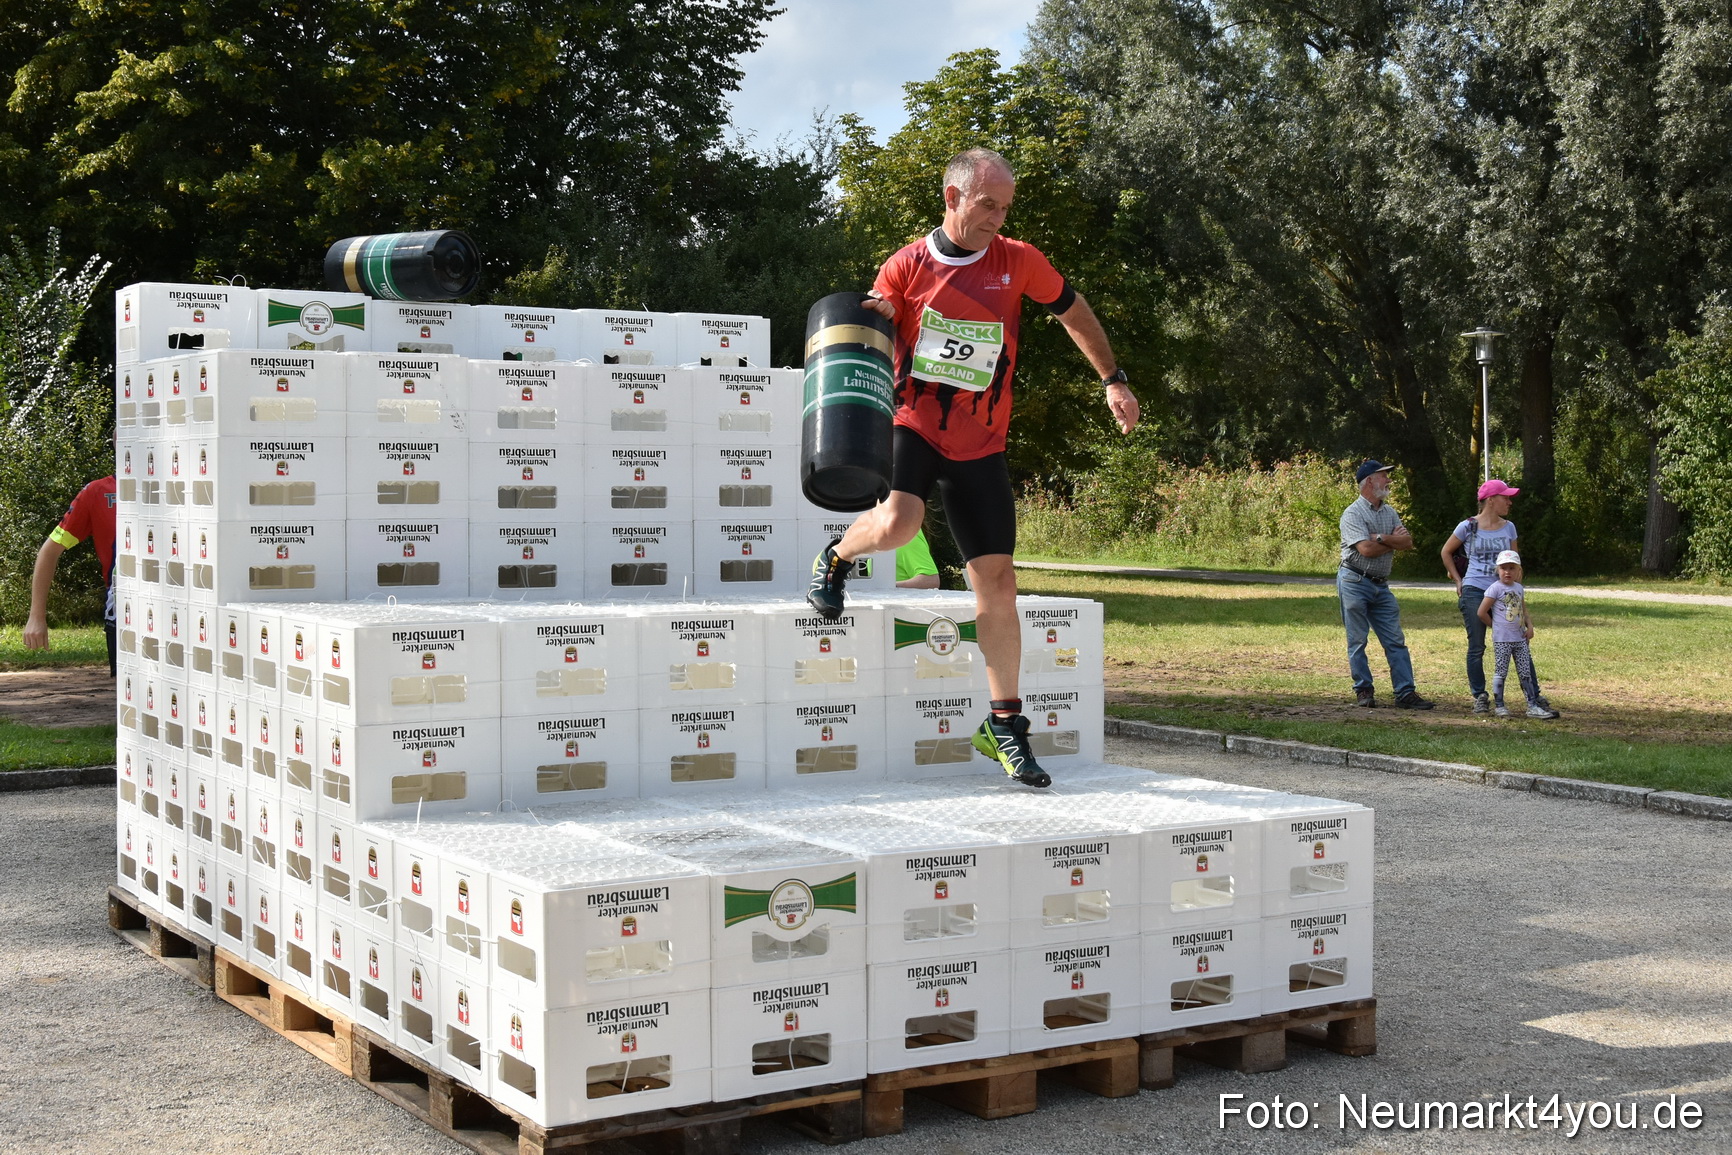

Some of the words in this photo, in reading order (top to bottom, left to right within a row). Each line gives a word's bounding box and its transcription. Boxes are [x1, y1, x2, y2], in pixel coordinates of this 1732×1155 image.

[169, 291, 228, 303] Lammsbräu
[177, 301, 220, 310] Neumarkter
[399, 308, 452, 319] Lammsbräu
[505, 313, 555, 324] Lammsbräu
[406, 317, 445, 326] Neumarkter
[511, 322, 548, 330] Neumarkter
[605, 317, 653, 327] Lammsbräu
[702, 320, 747, 330] Lammsbräu
[708, 328, 741, 336] Neumarkter
[939, 338, 974, 361] 59
[251, 358, 314, 369] Lammsbräu
[378, 360, 438, 372] Lammsbräu
[259, 368, 306, 377] Neumarkter
[387, 370, 431, 379] Neumarkter
[499, 369, 555, 380] Lammsbräu
[925, 362, 975, 381] ROLAND
[506, 378, 547, 387] Neumarkter
[612, 372, 666, 383] Lammsbräu
[720, 374, 770, 384] Lammsbräu
[619, 381, 658, 390] Neumarkter
[726, 383, 763, 391] Neumarkter
[250, 442, 314, 453] Lammsbräu
[378, 442, 438, 453] Lammsbräu
[259, 451, 305, 461] Neumarkter
[387, 452, 430, 461] Neumarkter
[499, 448, 556, 459] Lammsbräu
[612, 450, 666, 460] Lammsbräu
[720, 450, 771, 460] Lammsbräu
[507, 458, 548, 466] Neumarkter
[620, 459, 659, 467] Neumarkter
[727, 458, 764, 466] Neumarkter
[251, 525, 314, 536] Lammsbräu
[378, 524, 438, 535] Lammsbräu
[500, 527, 556, 538] Lammsbräu
[612, 527, 666, 538] Lammsbräu
[721, 524, 772, 534] Lammsbräu
[259, 534, 305, 544] Neumarkter
[387, 534, 430, 542] Neumarkter
[507, 536, 548, 545] Neumarkter
[619, 536, 659, 544] Neumarkter
[728, 533, 765, 541] Neumarkter
[1026, 609, 1078, 622] Lammsbräu
[672, 620, 734, 634] Lammsbräu
[1032, 619, 1070, 629] Neumarkter
[392, 629, 464, 645] Lammsbräu
[537, 624, 604, 639] Lammsbräu
[680, 631, 725, 641] Neumarkter
[803, 627, 846, 637] Neumarkter
[546, 636, 595, 646] Neumarkter
[402, 642, 454, 652] Neumarkter
[1026, 692, 1078, 705] Lammsbräu
[916, 698, 971, 711] Lammsbräu
[1033, 702, 1071, 711] Neumarkter
[797, 704, 856, 718] Lammsbräu
[923, 709, 964, 718] Neumarkter
[672, 710, 734, 726] Lammsbräu
[804, 715, 848, 725] Neumarkter
[538, 717, 605, 733] Lammsbräu
[680, 722, 726, 732] Neumarkter
[393, 726, 464, 742] Lammsbräu
[547, 730, 596, 741] Neumarkter
[402, 738, 455, 750] Neumarkter
[1291, 818, 1346, 835] Lammsbräu
[1172, 830, 1232, 848] Lammsbräu
[1298, 831, 1339, 842] Neumarkter
[1045, 842, 1109, 860] Lammsbräu
[1180, 844, 1224, 855] Neumarkter
[907, 854, 976, 872] Lammsbräu
[1053, 856, 1100, 868] Neumarkter
[915, 868, 967, 881] Neumarkter
[587, 886, 669, 908] Lammsbräu
[598, 903, 658, 918] Neumarkter
[1290, 914, 1346, 931] Lammsbräu
[1172, 929, 1232, 947] Lammsbräu
[1298, 928, 1339, 938] Neumarkter
[1045, 945, 1110, 964] Lammsbräu
[1180, 944, 1224, 956] Neumarkter
[908, 961, 977, 980] Lammsbräu
[1053, 960, 1100, 972] Neumarkter
[916, 976, 967, 990] Neumarkter
[753, 982, 829, 1004] Lammsbräu
[762, 999, 818, 1014] Neumarkter
[587, 1001, 669, 1026] Lammsbräu
[597, 1019, 658, 1035] Neumarkter
